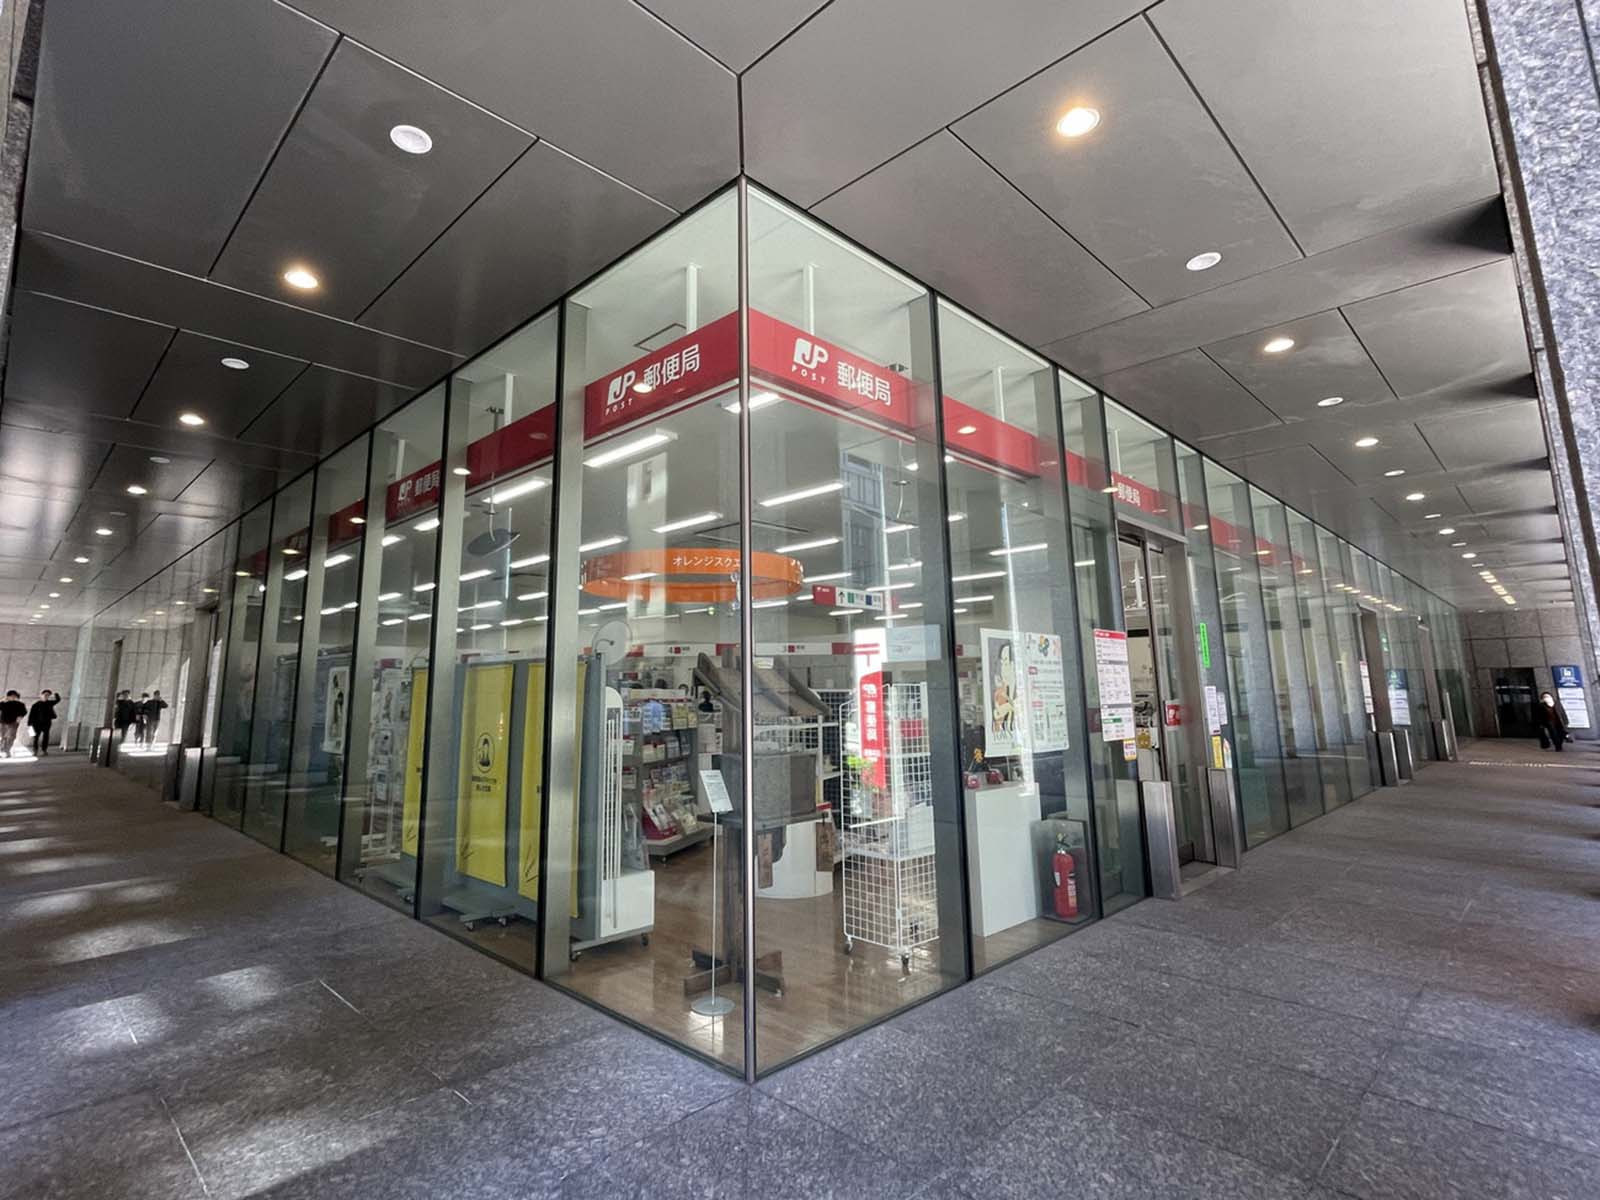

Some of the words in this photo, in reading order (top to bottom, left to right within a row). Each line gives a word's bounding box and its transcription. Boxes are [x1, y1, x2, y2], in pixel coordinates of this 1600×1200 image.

[643, 343, 700, 390] 郵便局
[791, 363, 826, 385] POST
[837, 360, 892, 406] 郵便局
[605, 398, 633, 416] POST
